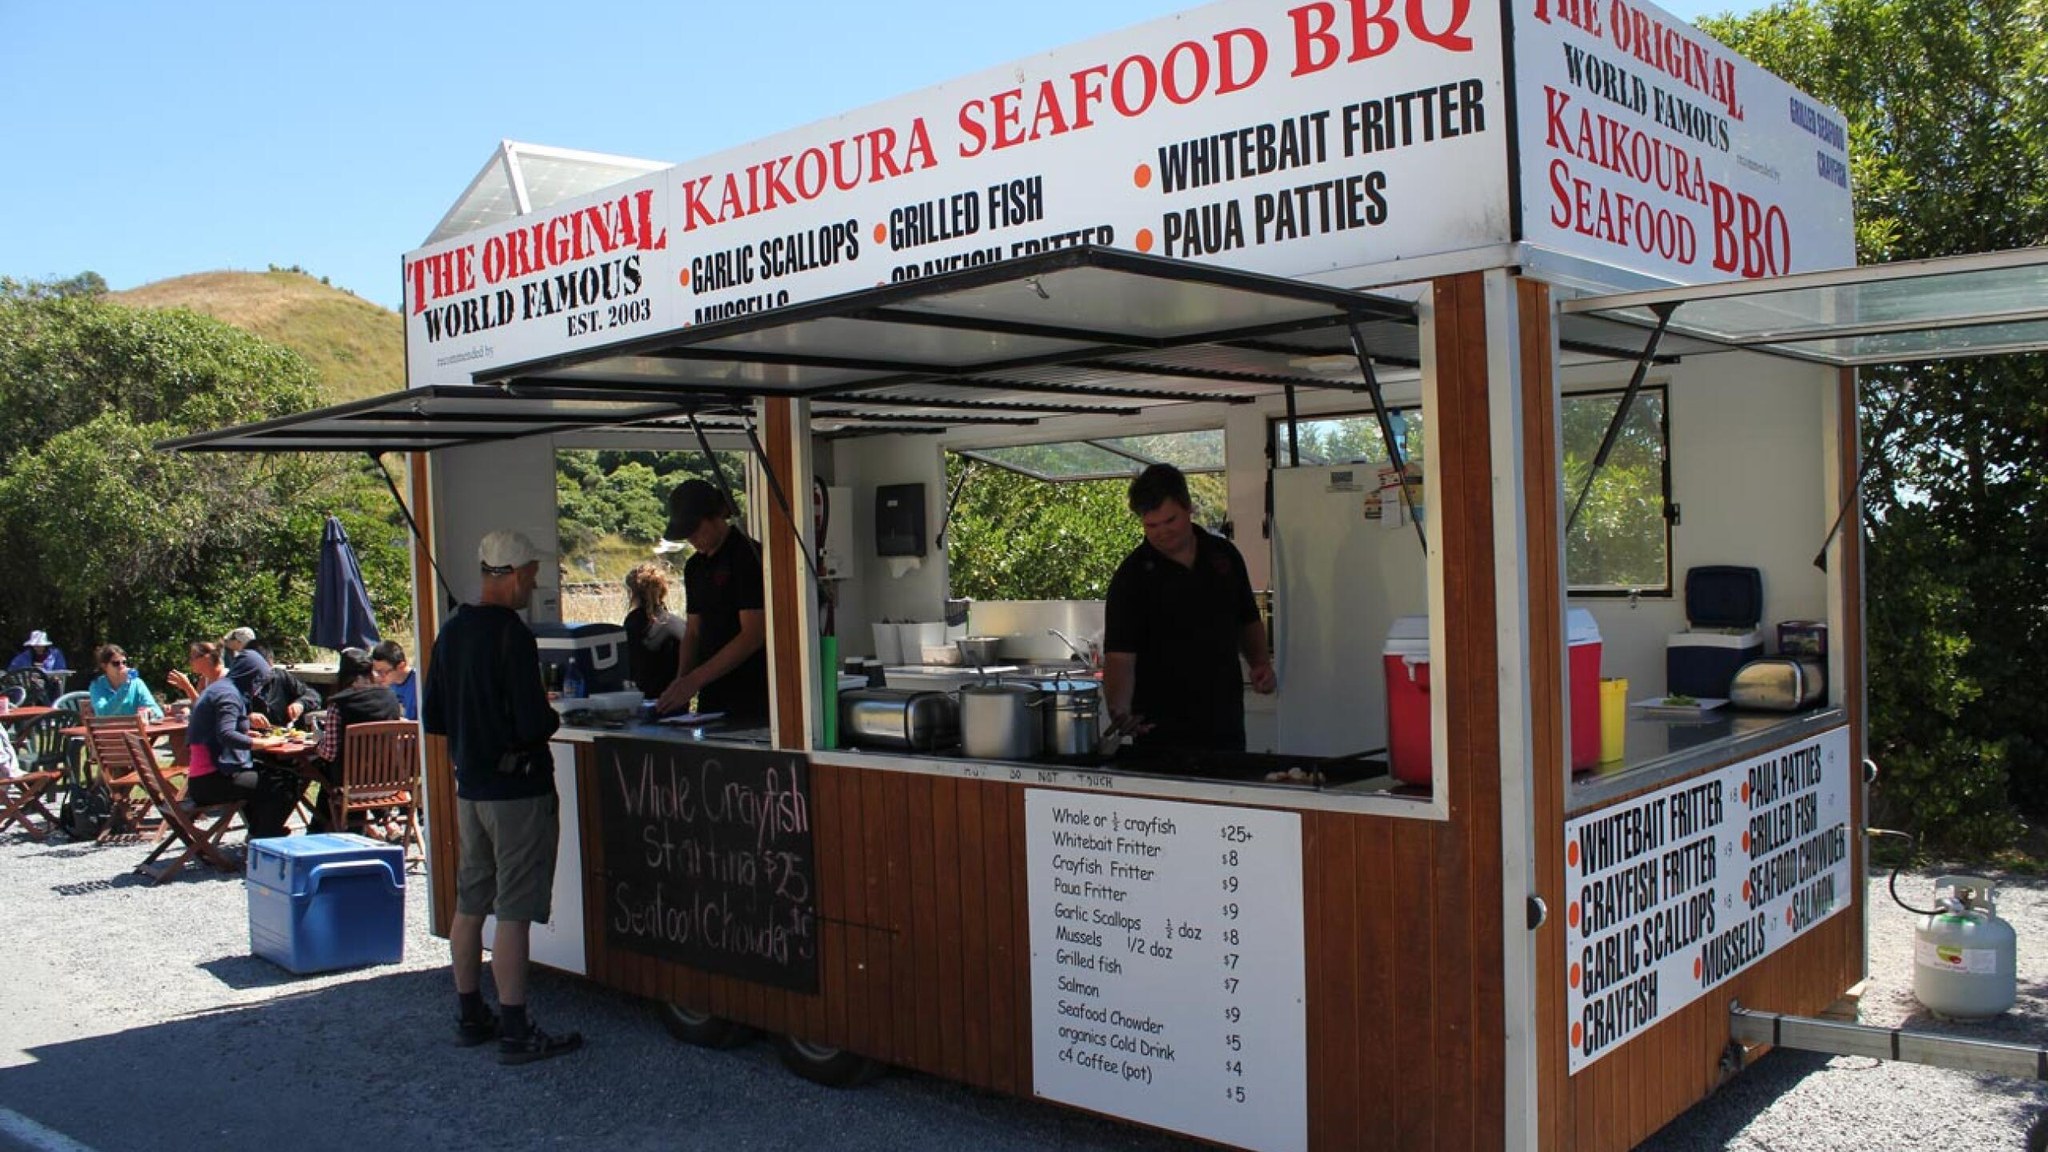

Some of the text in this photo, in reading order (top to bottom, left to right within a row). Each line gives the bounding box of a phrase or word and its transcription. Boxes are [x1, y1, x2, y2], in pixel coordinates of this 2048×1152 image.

[1563, 42, 1730, 153] WORLD FAMOUS
[1610, 0, 1744, 121] ORIGINAL
[682, 0, 1473, 232] KAIKOURA SEAFOOD BBQ
[1158, 78, 1485, 194] WHITEBAIT FRITTER
[1544, 85, 1709, 206] KAIKOURA
[890, 191, 979, 251] GRILLED
[988, 175, 1043, 230] FISH
[1163, 200, 1245, 258] PAUA
[1254, 171, 1387, 245] PATTIES
[1550, 158, 1696, 265] SEAFOOD
[407, 189, 666, 316] THE ORIGINAL
[691, 245, 754, 295] GARLIC
[759, 219, 859, 280] SCALLOPS
[423, 290, 514, 343] WORLD
[521, 254, 642, 320] FAMOUS
[567, 298, 651, 338] EST. 2003
[613, 751, 809, 855] Whole Crayfish
[1749, 743, 1821, 811] PAUA PATTIES
[1052, 807, 1090, 827] Whole
[1093, 814, 1107, 828] or
[1124, 816, 1176, 838] crayfish
[1221, 825, 1253, 843] $25+
[1052, 831, 1239, 867] Whitebait Fritter $8
[1579, 796, 1666, 877] WHITEBAIT
[1670, 779, 1723, 842] FRITTER
[1749, 791, 1817, 861] GRILLED FISH
[763, 851, 809, 901] $25
[1052, 854, 1239, 893] Crayfish Fritter $9
[1054, 878, 1239, 920] Paua Fritter $9
[1581, 856, 1658, 938] CRAYFISH
[1663, 835, 1716, 901] FRITTER
[1749, 822, 1846, 911] SEAFOOD CHOWDER
[1792, 872, 1834, 933] SALMON
[1055, 902, 1088, 922] Garlic
[1093, 908, 1141, 933] Scallops
[1178, 922, 1202, 941] doz
[1223, 929, 1240, 946] $8
[1055, 926, 1239, 970] Mussels 1/2 doz $7
[1582, 923, 1639, 999] GARLIC
[1643, 887, 1716, 967] SCALLOPS
[1702, 912, 1765, 989] MUSSELLS
[1056, 950, 1239, 994] Grilled fish $7
[1058, 976, 1240, 1023] Salmon $9
[1058, 1001, 1241, 1051] Seafood Chowder $5
[1058, 1026, 1243, 1077] organics Cold Drink $4
[1582, 971, 1658, 1057] CRAYFISH
[1058, 1048, 1246, 1104] c4 Coffee (pot) $5
